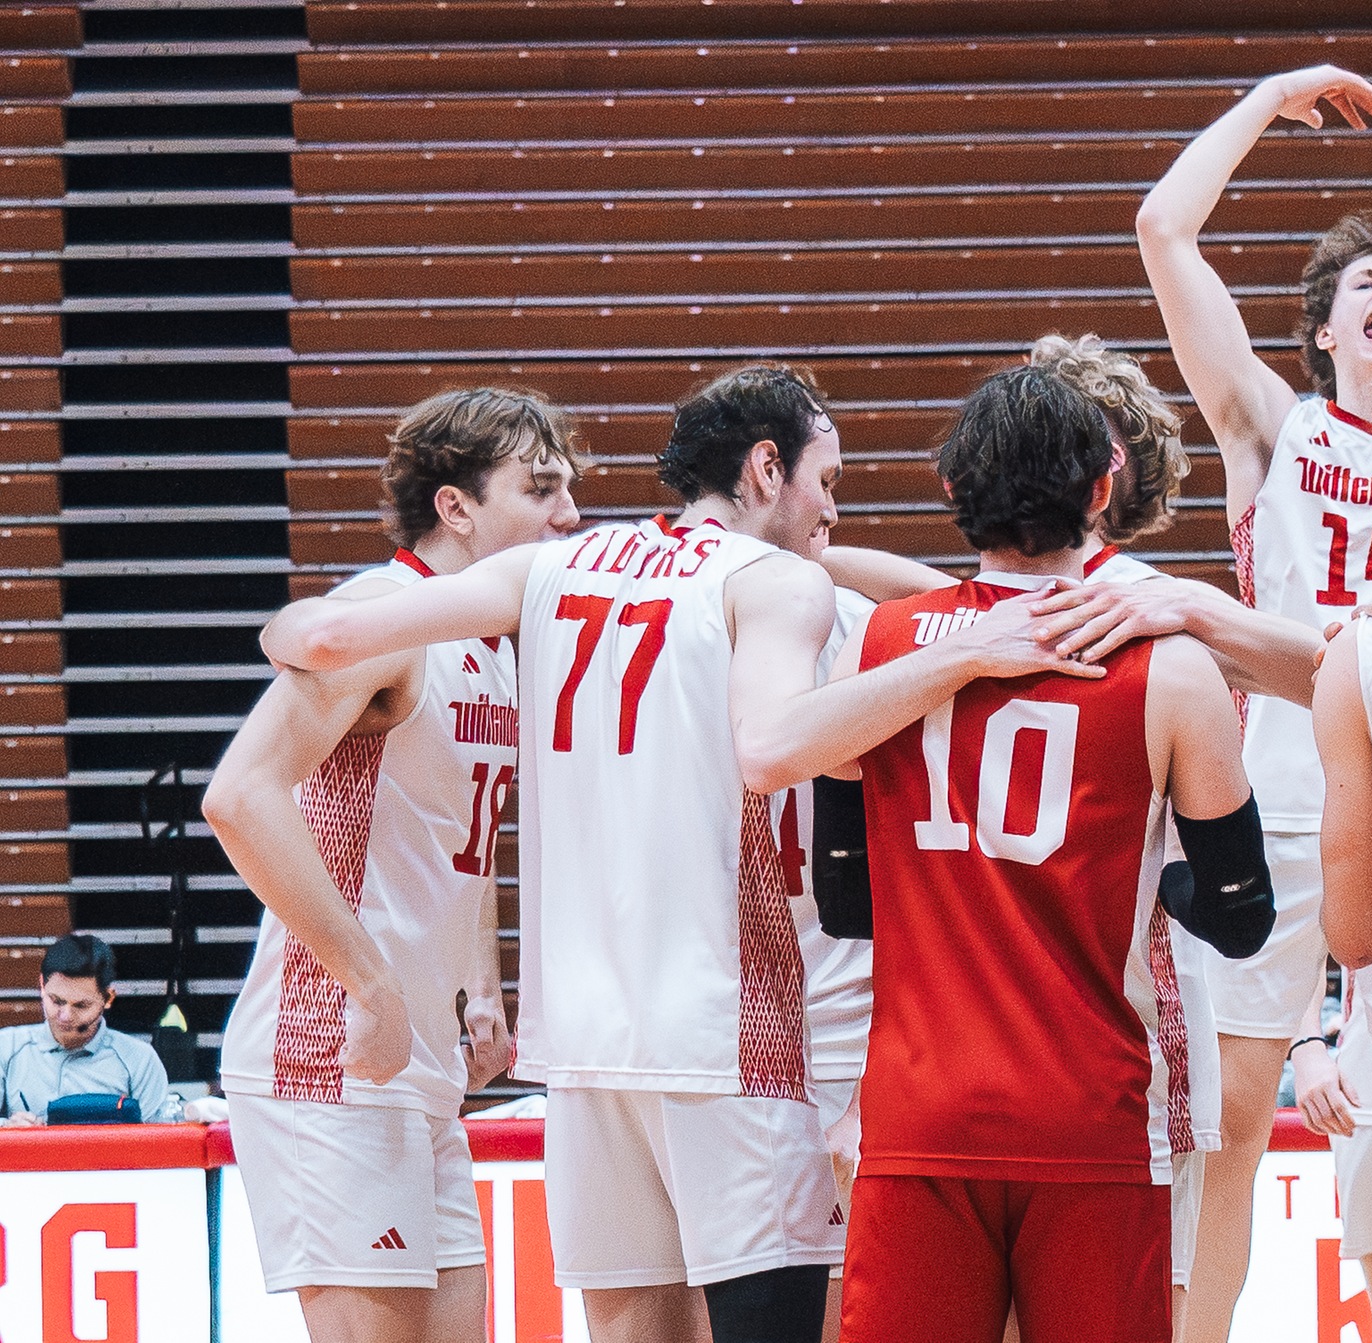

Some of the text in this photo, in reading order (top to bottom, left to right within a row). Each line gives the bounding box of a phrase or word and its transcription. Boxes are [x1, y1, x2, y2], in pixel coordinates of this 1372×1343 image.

[552, 593, 674, 756] 77
[913, 698, 1080, 866] 10
[0, 1203, 138, 1343] G
